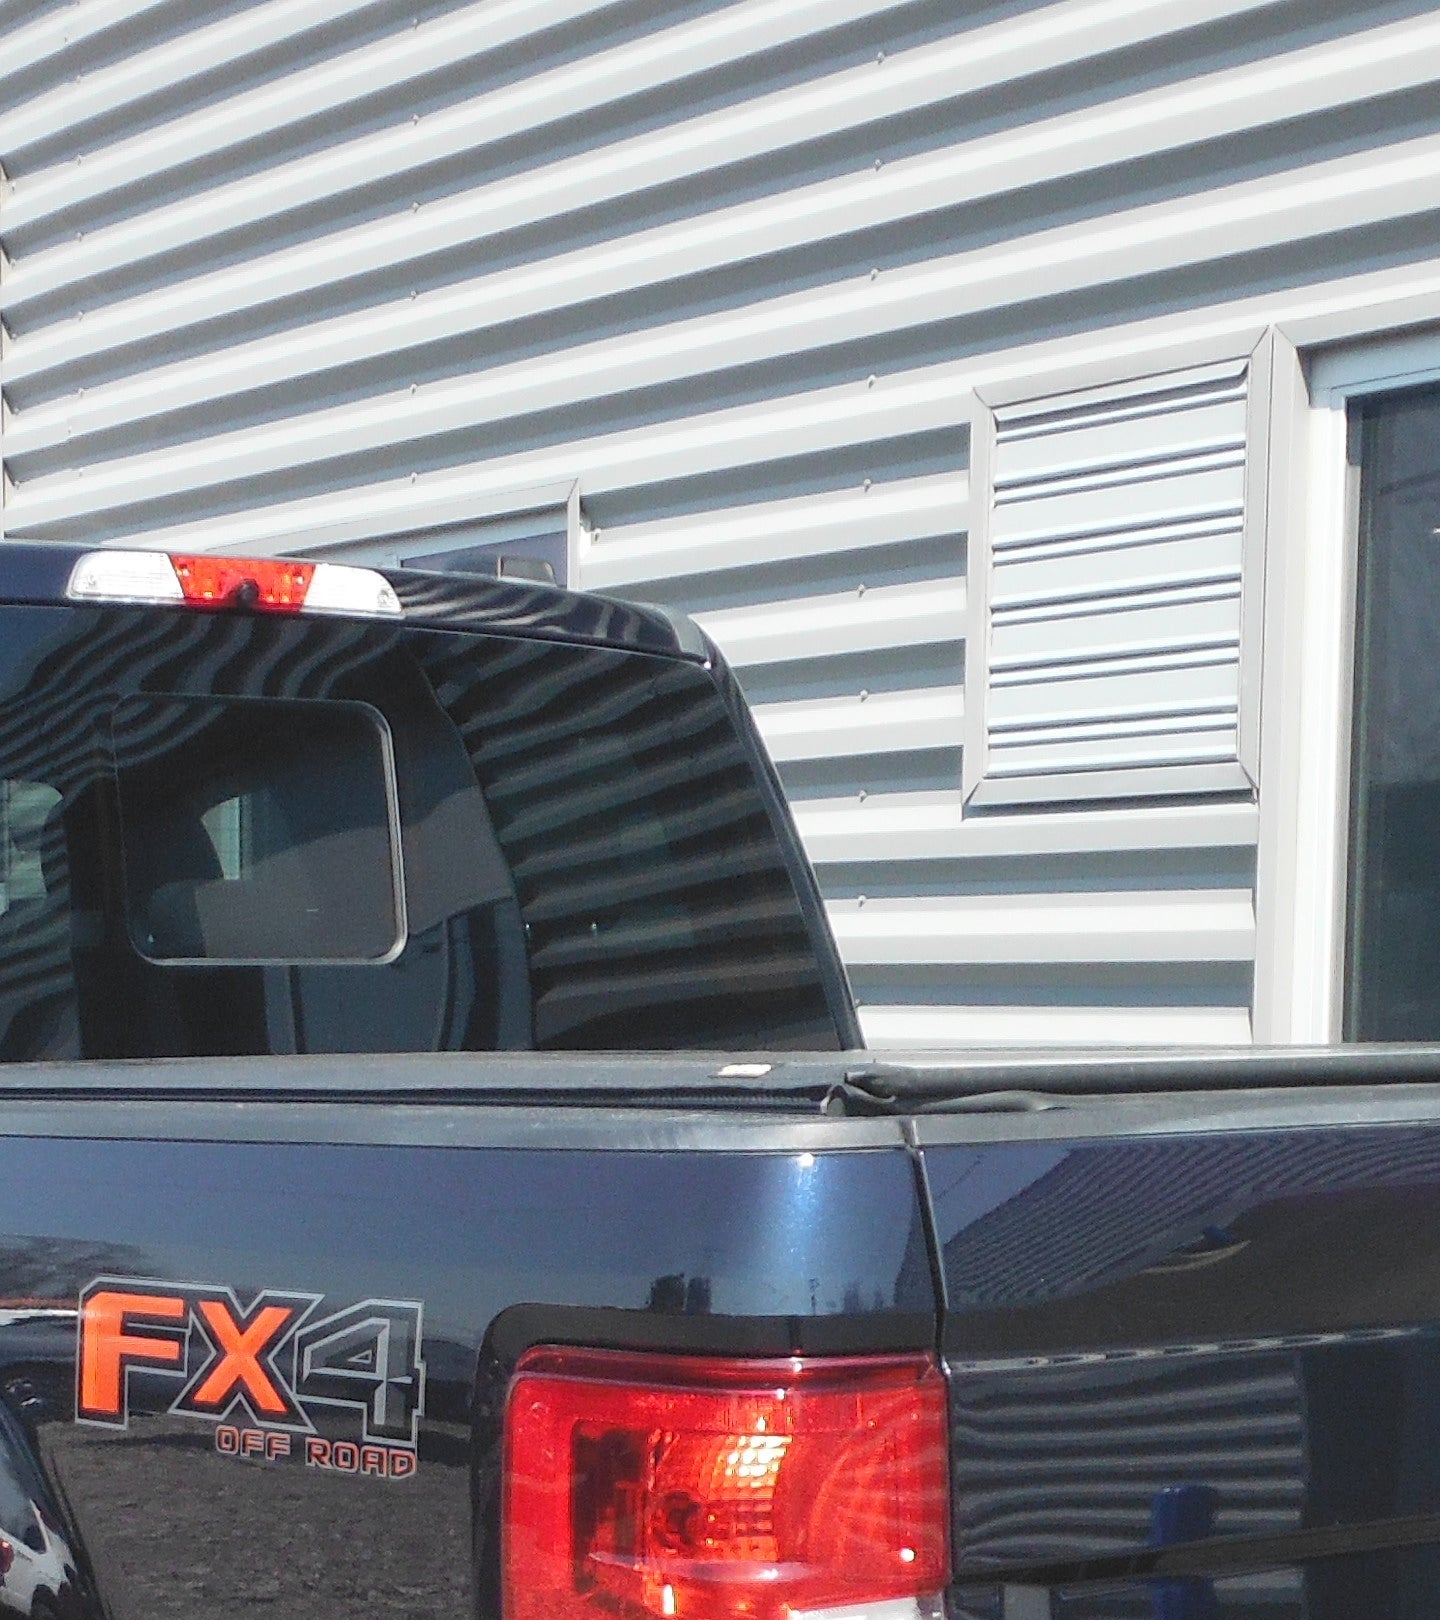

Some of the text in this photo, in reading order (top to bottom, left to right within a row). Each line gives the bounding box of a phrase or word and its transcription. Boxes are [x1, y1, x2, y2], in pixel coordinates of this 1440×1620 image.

[75, 1275, 426, 1450] FX4
[215, 1424, 419, 1480] OFF ROAD
